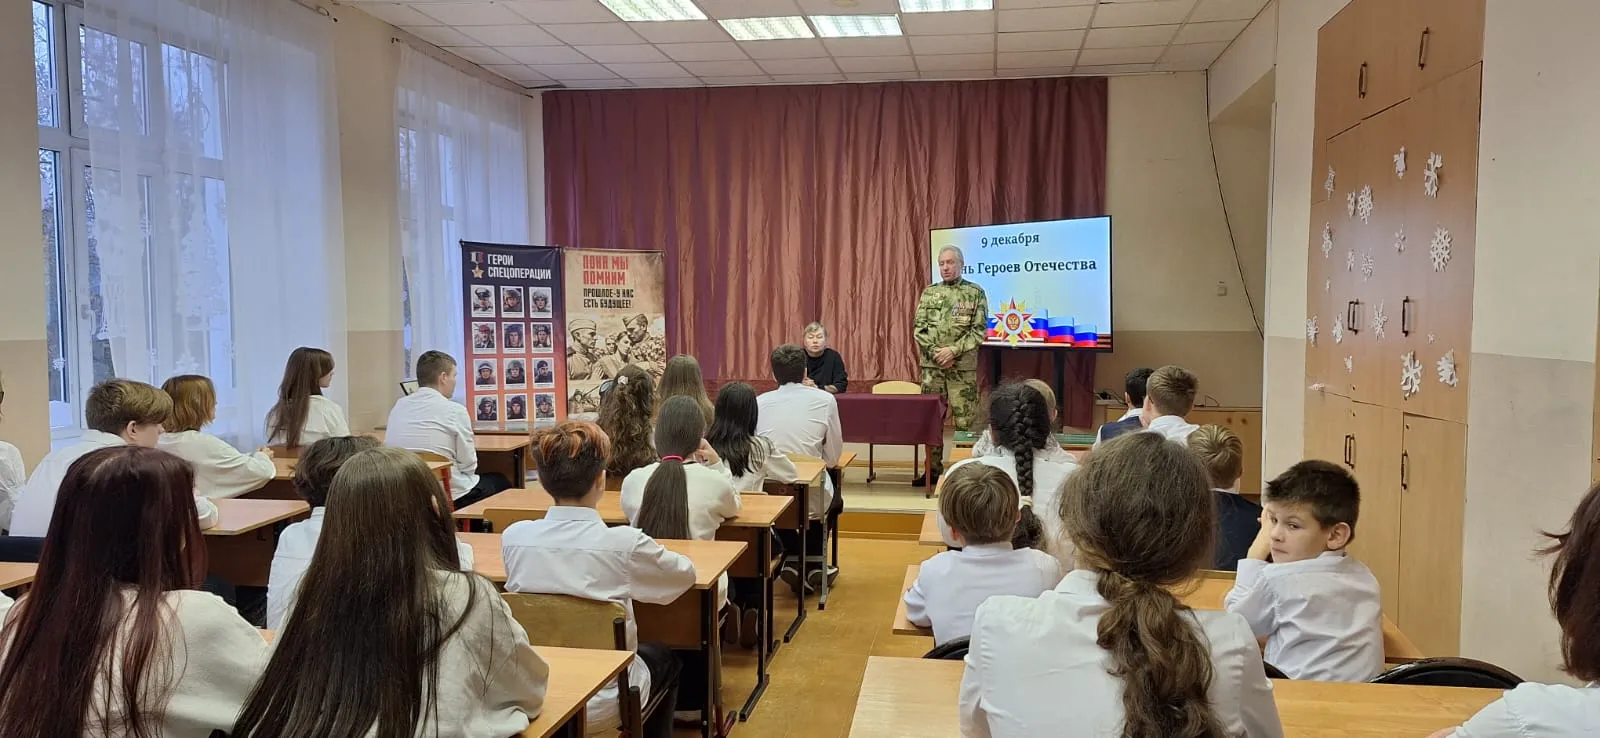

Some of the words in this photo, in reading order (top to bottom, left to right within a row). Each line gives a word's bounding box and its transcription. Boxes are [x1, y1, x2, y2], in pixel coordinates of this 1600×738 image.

[981, 237, 988, 248] 9
[991, 233, 1039, 247] декабря
[487, 254, 514, 266] ГЕРОИ
[583, 255, 608, 269] ПОКА
[612, 255, 629, 270] МЫ
[487, 266, 552, 280] СПЕЦОПЕРАЦИИ
[961, 264, 975, 275] нь
[977, 262, 1021, 276] Героев
[1024, 259, 1096, 272] Отечества
[583, 271, 626, 285] ПОМНИМ
[583, 298, 599, 308] ЕСТЬ
[600, 299, 632, 309] БУДУЩЕЕ!
